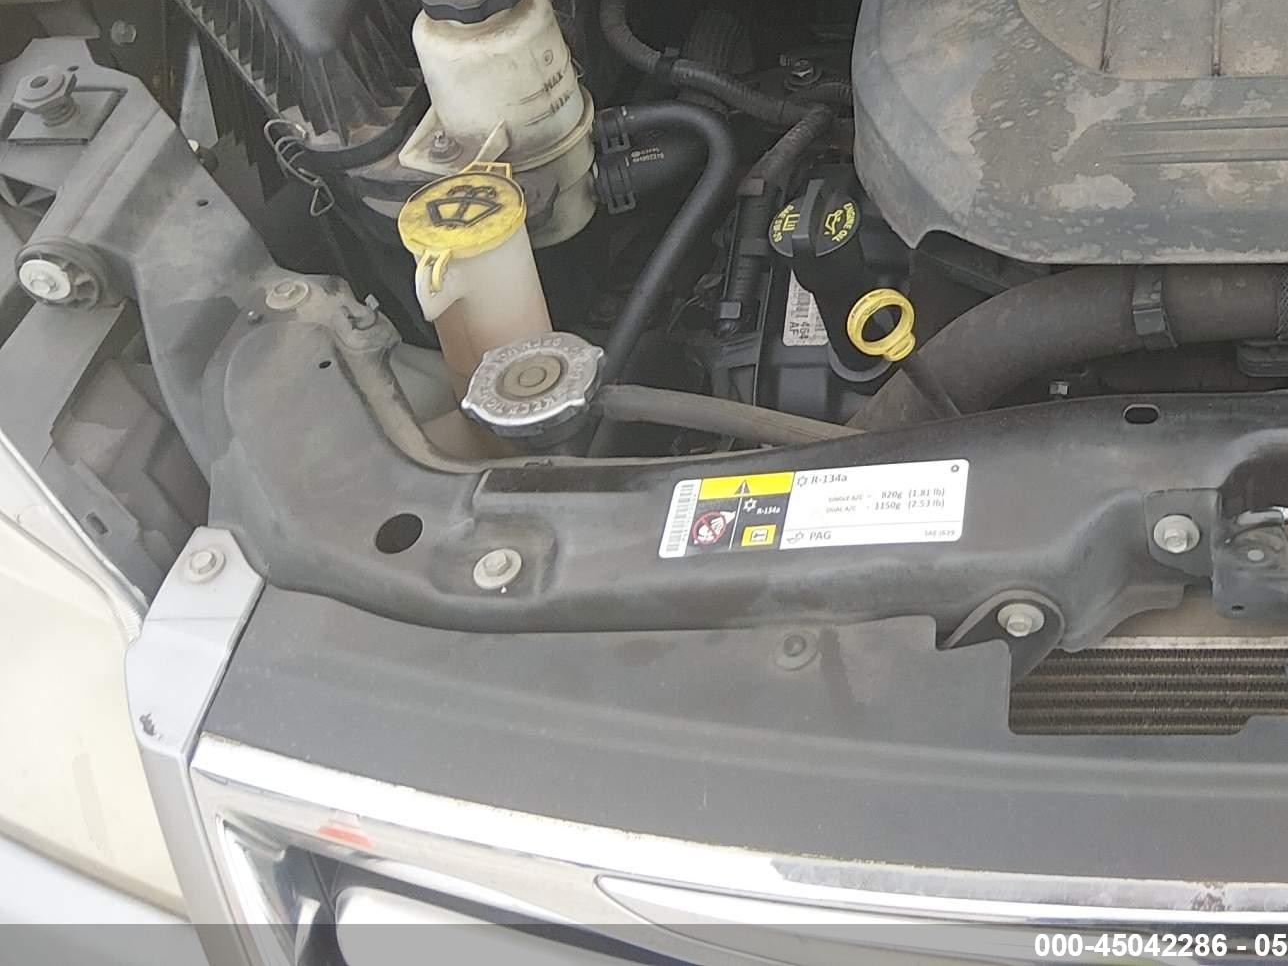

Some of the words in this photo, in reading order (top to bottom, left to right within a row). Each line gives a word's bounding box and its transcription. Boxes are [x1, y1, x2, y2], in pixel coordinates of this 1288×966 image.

[843, 202, 856, 230] ENGINE
[832, 229, 848, 243] OIL
[811, 473, 848, 486] R-134a
[881, 490, 903, 501] 820g
[808, 529, 832, 542] PAG
